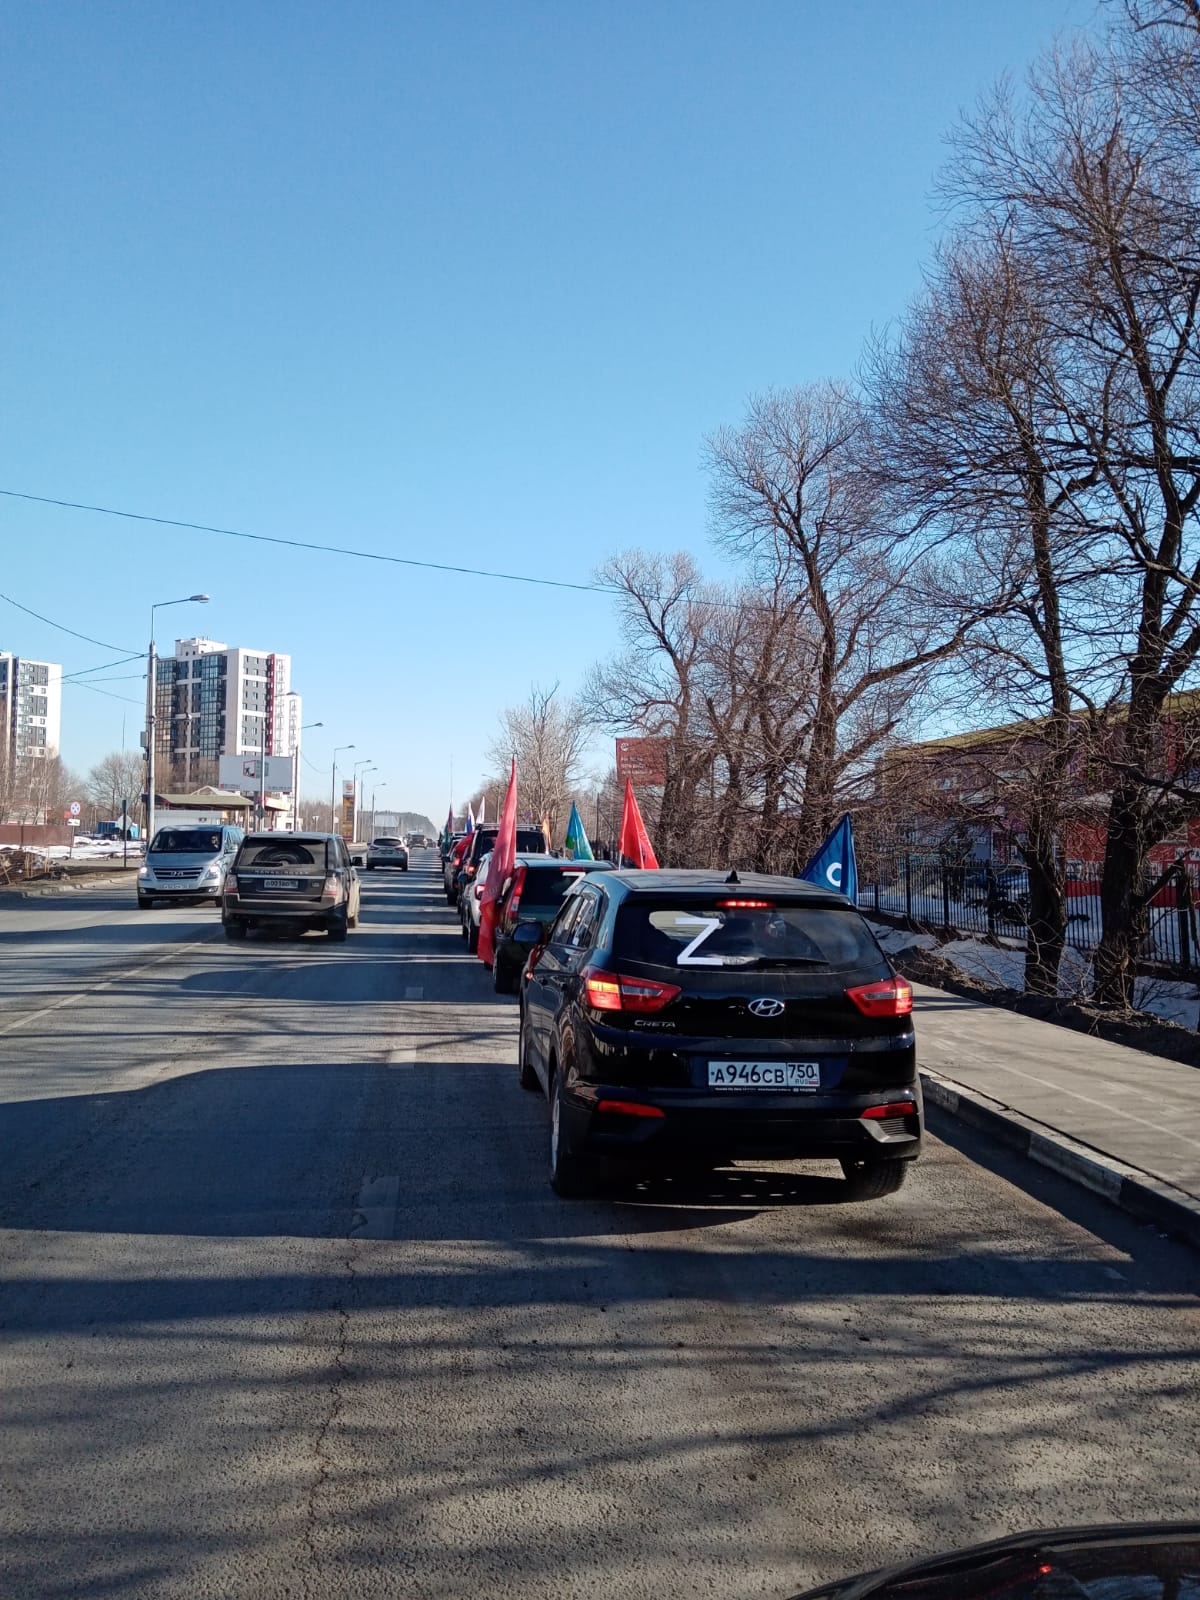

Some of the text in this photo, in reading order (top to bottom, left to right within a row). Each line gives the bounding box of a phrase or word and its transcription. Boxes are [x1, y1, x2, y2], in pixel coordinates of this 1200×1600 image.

[675, 917, 724, 966] Z
[634, 1019, 676, 1028] CRETA
[714, 1063, 814, 1083] А946СВ 750
